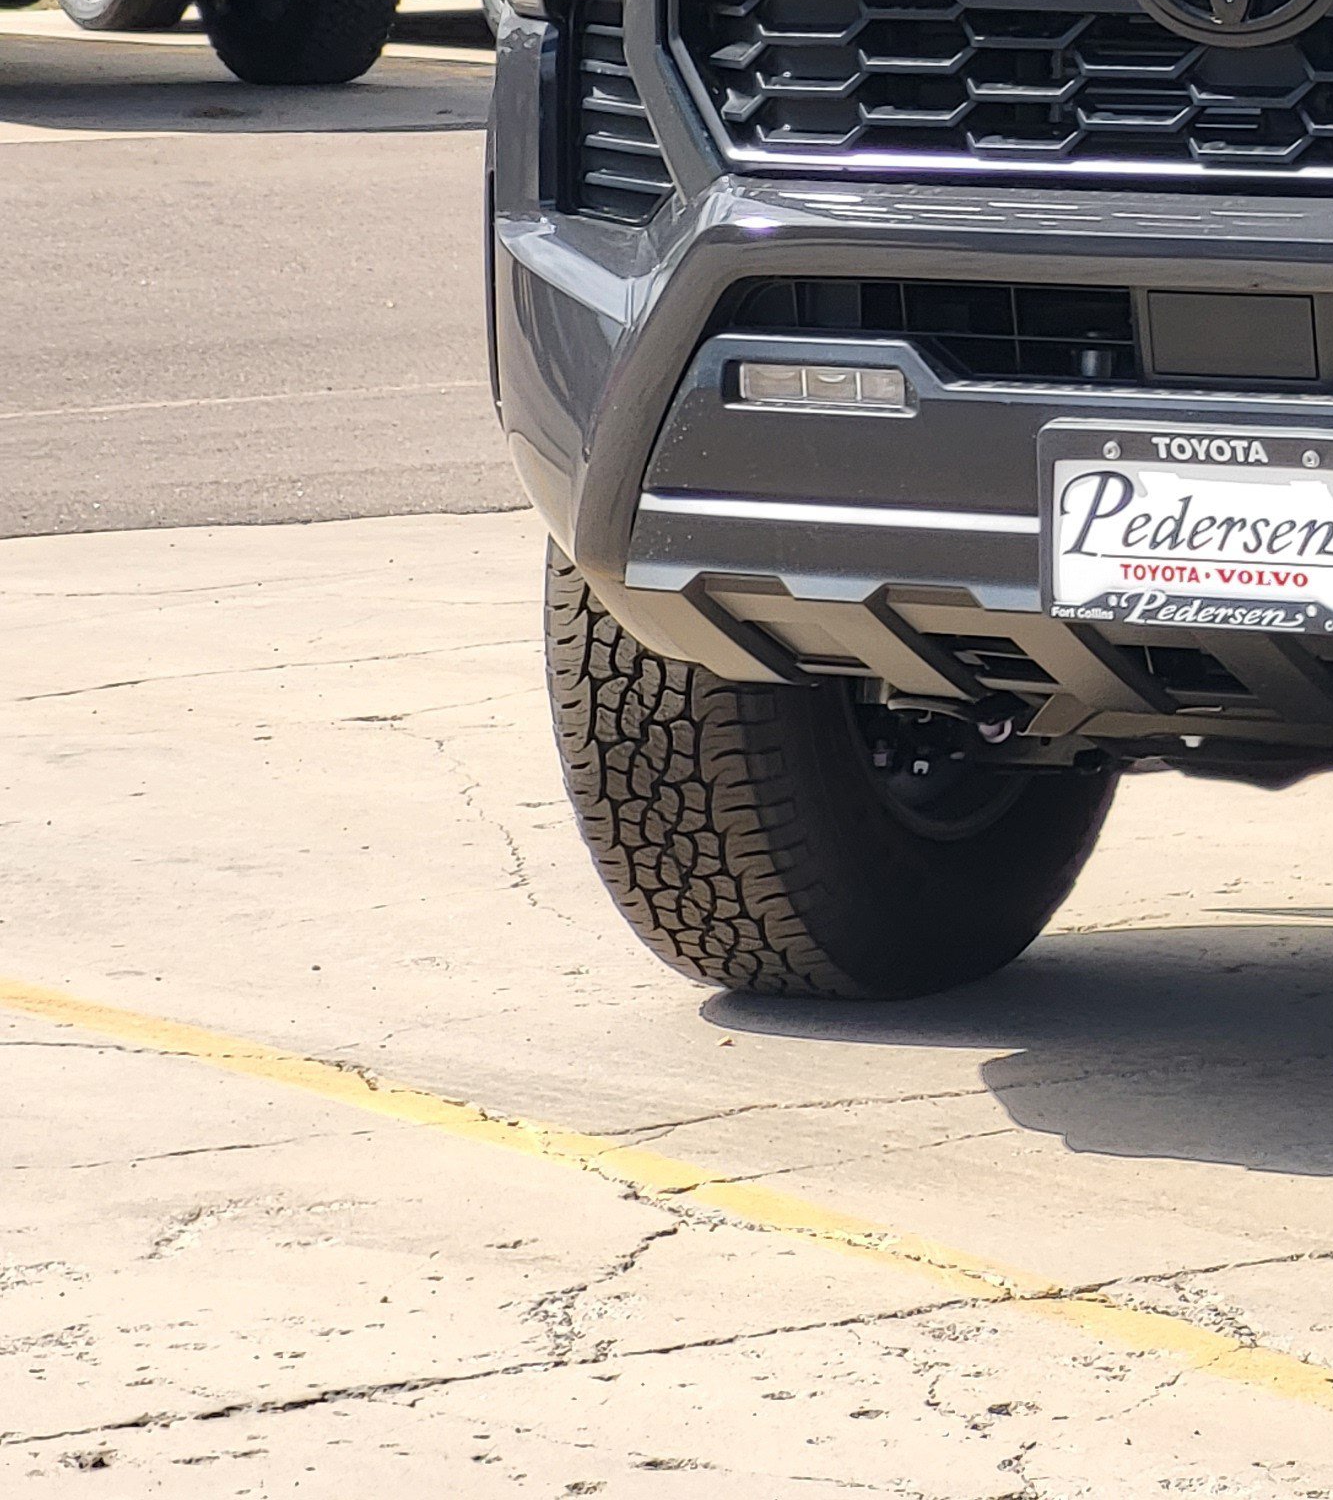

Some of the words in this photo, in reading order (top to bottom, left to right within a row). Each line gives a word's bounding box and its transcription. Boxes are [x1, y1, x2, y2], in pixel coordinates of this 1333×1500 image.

[1151, 436, 1269, 464] TOYOTA
[1120, 563, 1201, 583] TOYOTA
[1218, 567, 1309, 588] VOLVO
[1077, 607, 1114, 620] Collins
[1119, 589, 1305, 628] Pedersen
